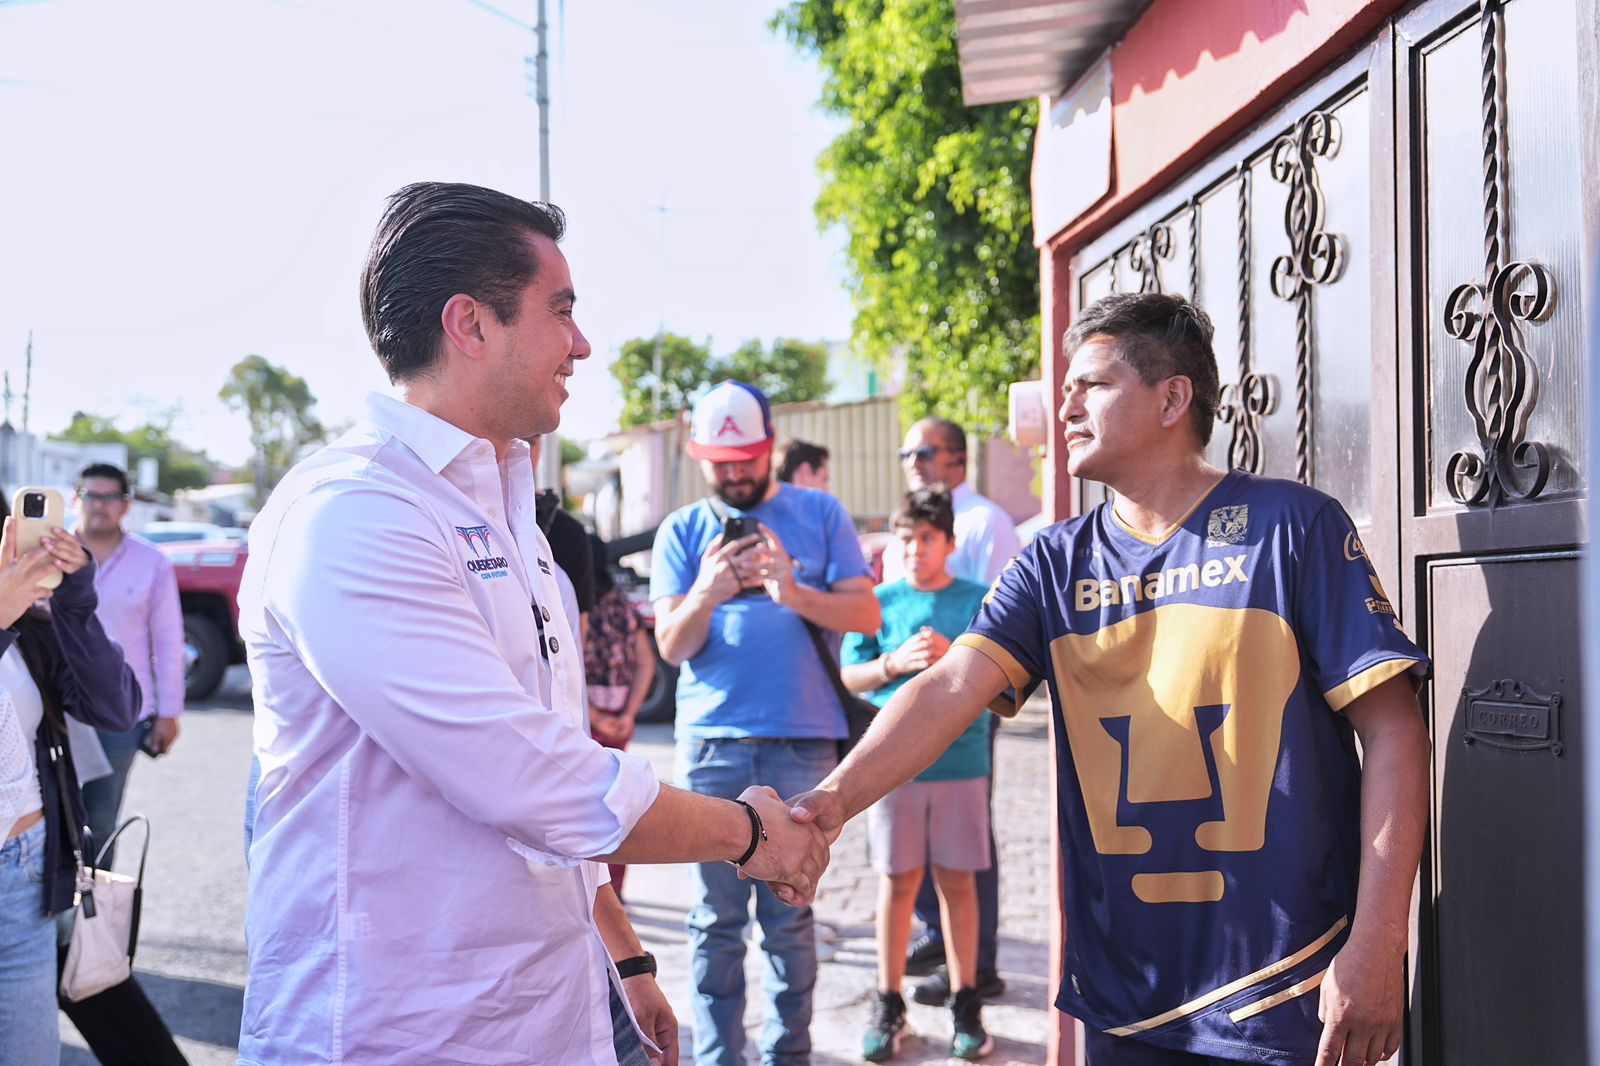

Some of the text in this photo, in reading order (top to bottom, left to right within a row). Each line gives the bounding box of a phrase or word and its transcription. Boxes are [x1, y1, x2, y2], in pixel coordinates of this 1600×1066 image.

[717, 416, 744, 437] A
[1074, 554, 1249, 612] Banamex
[1479, 710, 1540, 729] CORREO
